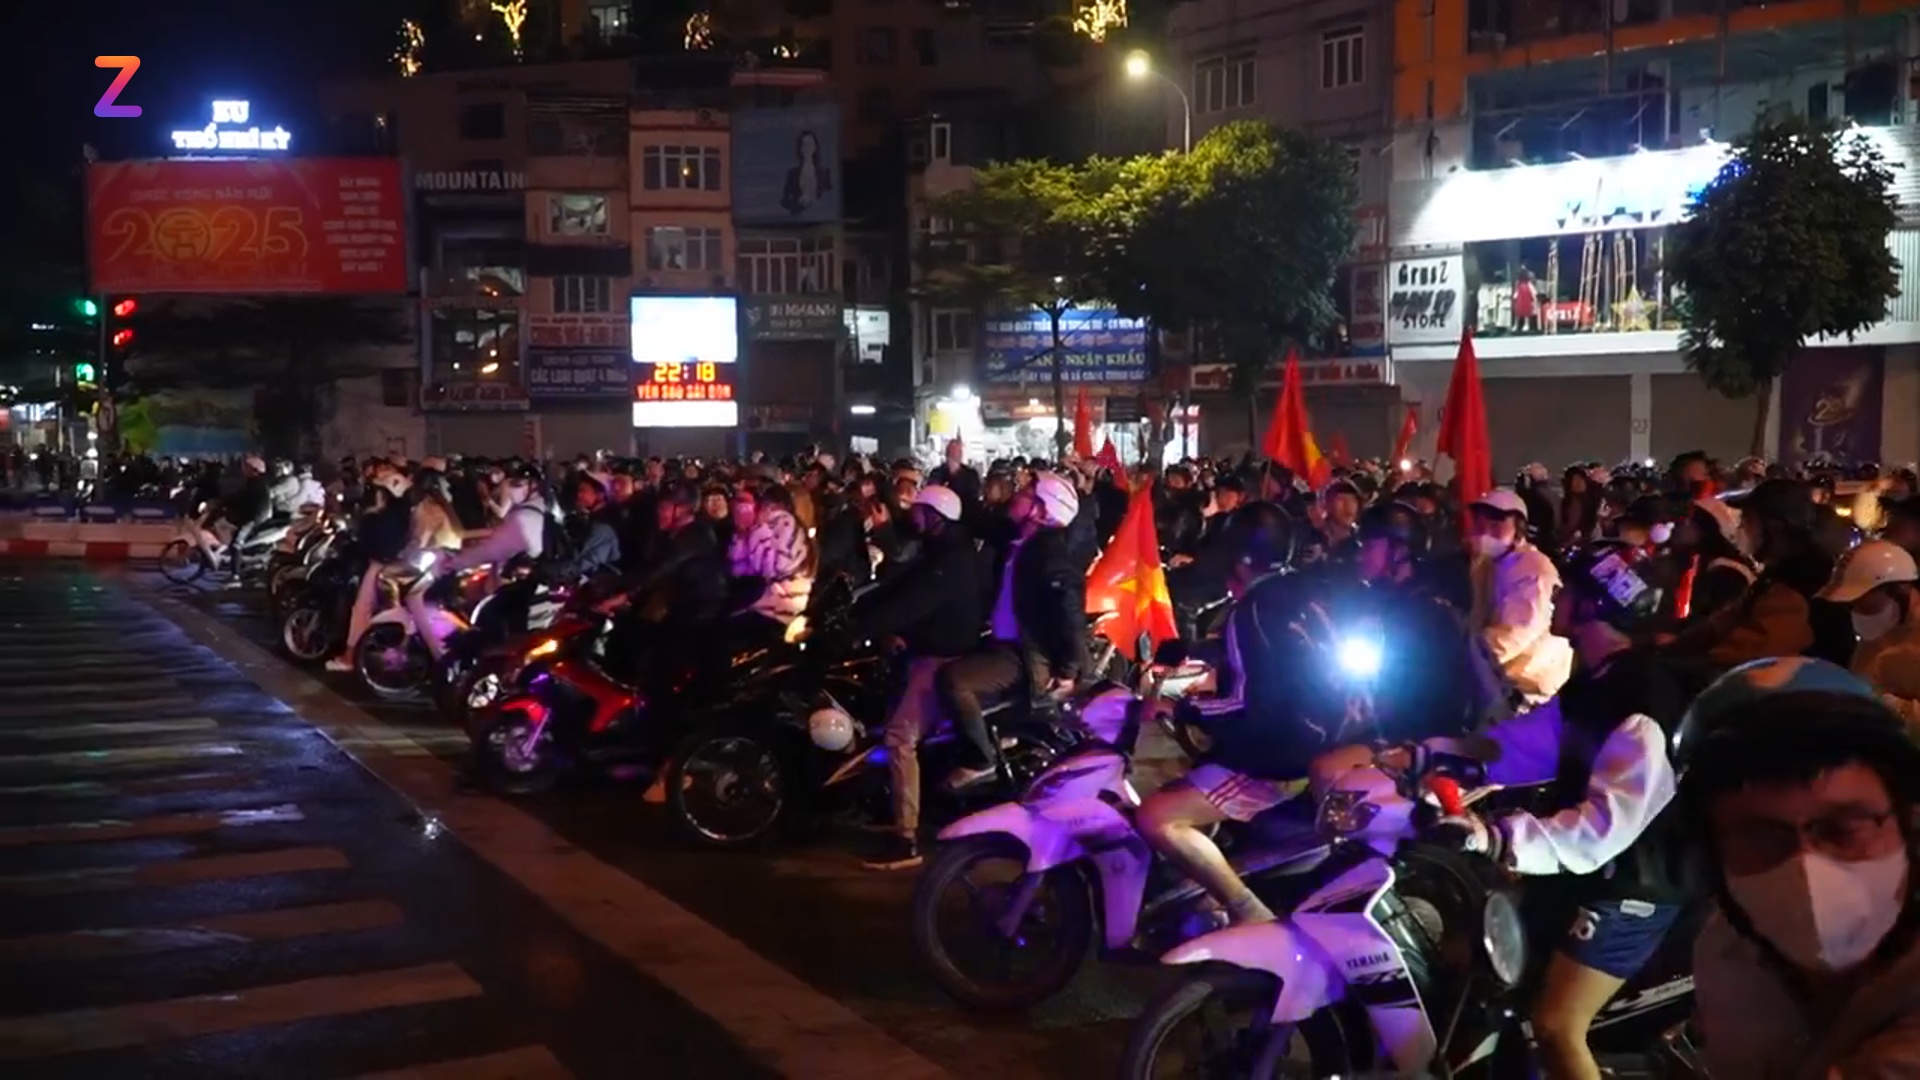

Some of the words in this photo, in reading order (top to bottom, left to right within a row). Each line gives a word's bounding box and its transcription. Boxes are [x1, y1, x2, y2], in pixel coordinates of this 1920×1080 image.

[415, 171, 525, 189] MOUNTAIN
[103, 206, 308, 262] 2025
[1403, 314, 1446, 329] STORE
[654, 362, 715, 382] 22:18
[1346, 952, 1390, 968] YAMAHA
